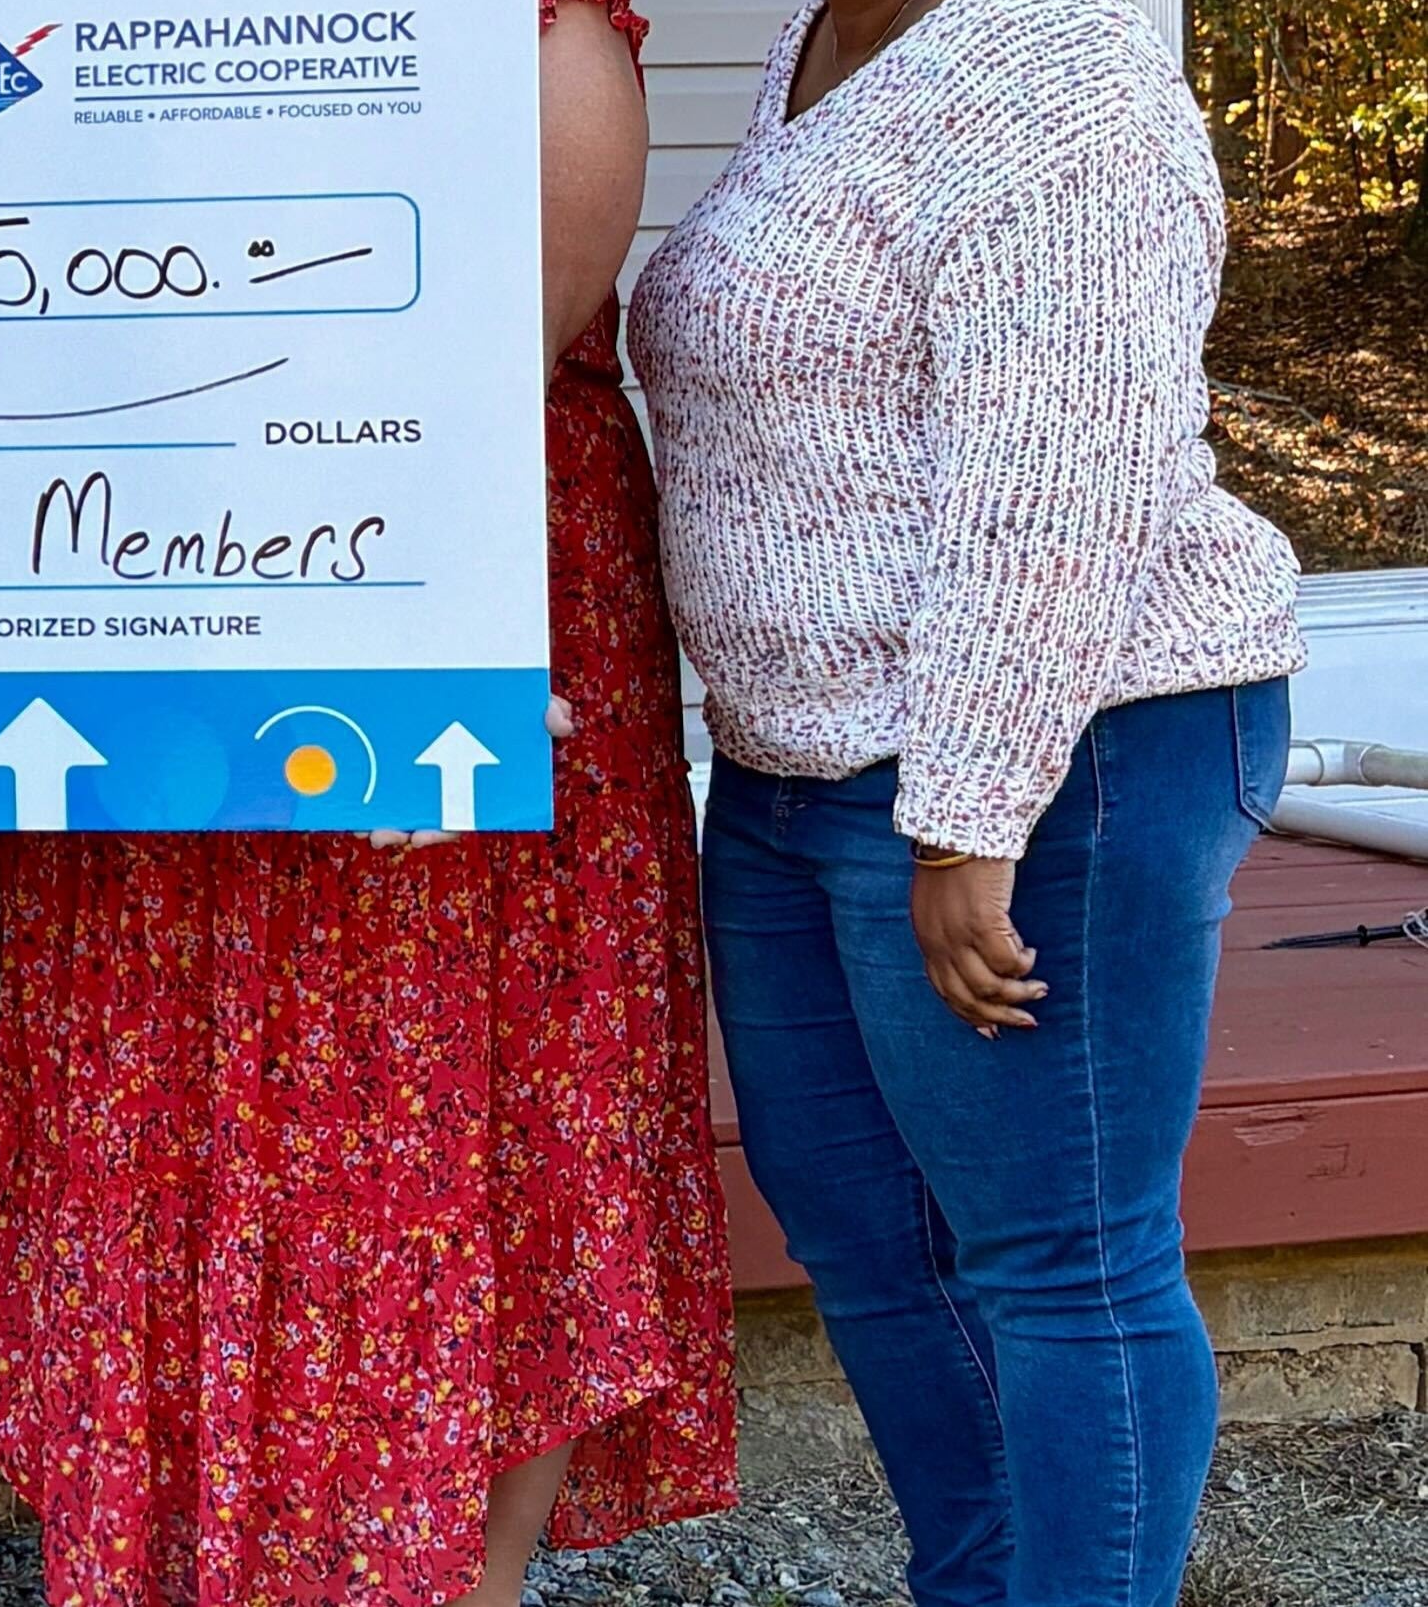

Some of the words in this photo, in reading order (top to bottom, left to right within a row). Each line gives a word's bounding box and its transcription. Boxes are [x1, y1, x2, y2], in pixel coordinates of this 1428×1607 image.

[75, 11, 416, 52] RAPPAHANNOCK
[75, 58, 206, 88] ELECTRIC
[214, 54, 418, 85] COOPERATIVE
[74, 110, 143, 124] RELIABLE
[160, 106, 262, 122] AFFORDABLE
[278, 103, 353, 118] FOCUSED
[357, 102, 383, 116] ON
[387, 101, 422, 115] YOU
[264, 419, 421, 446] DOLLARS
[32, 470, 385, 581] Members
[104, 614, 261, 638] SIGNATURE
